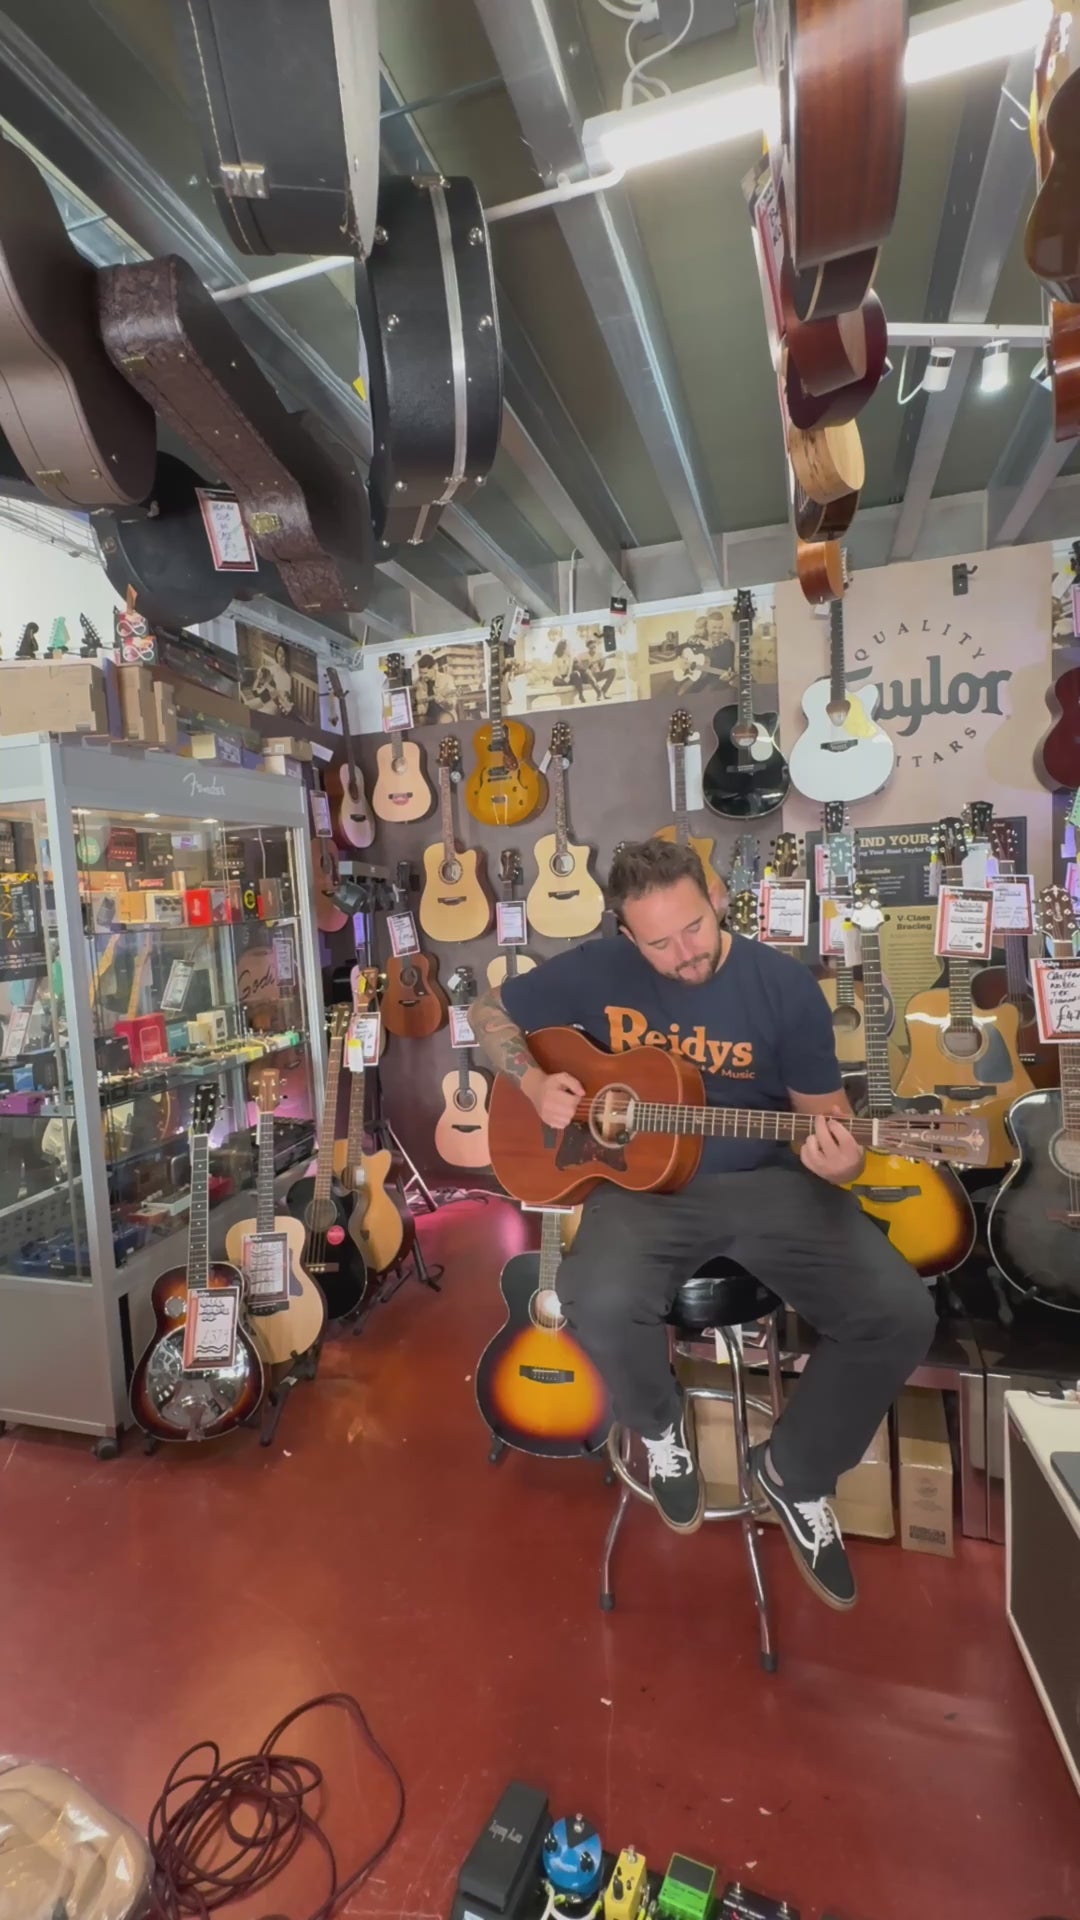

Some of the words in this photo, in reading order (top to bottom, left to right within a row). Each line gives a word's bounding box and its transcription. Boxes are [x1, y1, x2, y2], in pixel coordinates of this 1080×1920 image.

[854, 619, 986, 662] QUALITY
[844, 655, 1013, 737] ylor
[895, 726, 977, 768] ITARS
[859, 836, 886, 848] IND
[888, 833, 930, 846] YOUR
[903, 846, 924, 854] Taylor
[896, 922, 933, 931] Bracing
[604, 1005, 753, 1074] Reidys
[721, 1068, 756, 1079] Music
